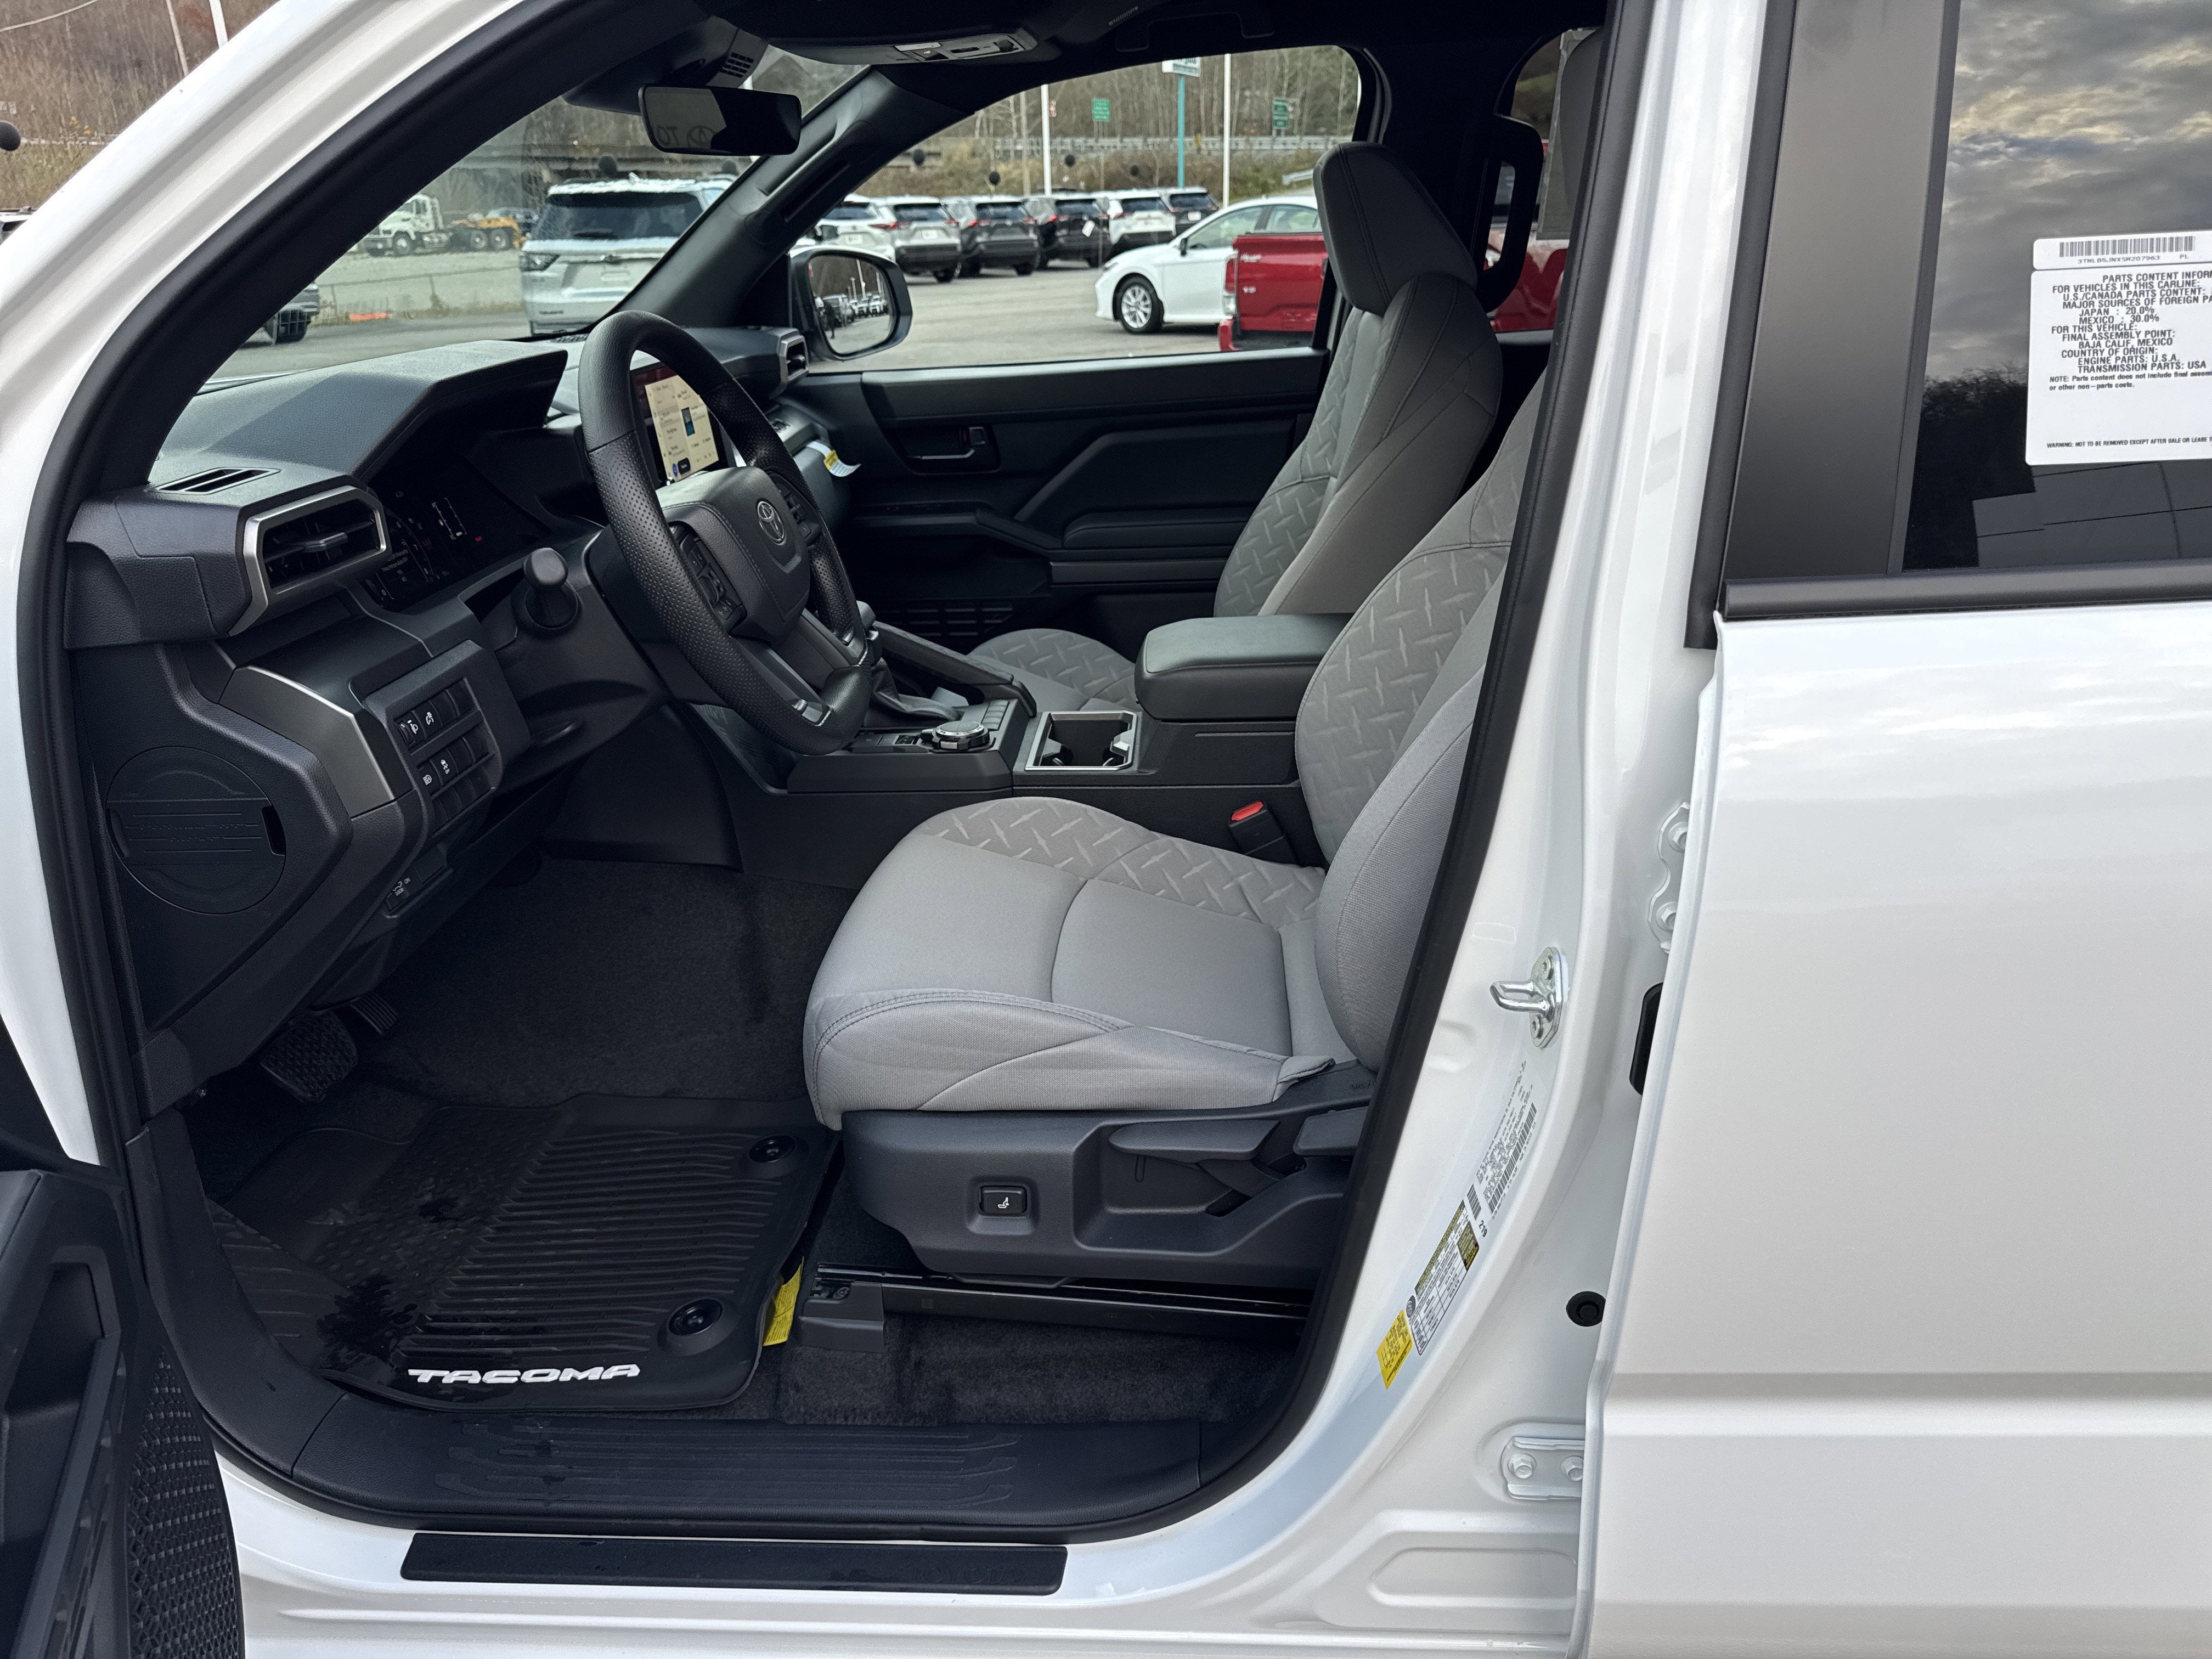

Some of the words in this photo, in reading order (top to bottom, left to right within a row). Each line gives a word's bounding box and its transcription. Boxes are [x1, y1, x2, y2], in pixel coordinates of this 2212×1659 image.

[2078, 255, 2160, 264] 3TMLB5JNXSM207963
[2102, 274, 2132, 283] PARTS
[2136, 272, 2179, 281] CONTENT
[2052, 285, 2070, 294] FOR
[2073, 283, 2117, 292] VEHICLES
[2120, 282, 2129, 290] IN
[2134, 281, 2154, 290] THIS
[2158, 279, 2200, 289] CARLINE:
[2063, 291, 2123, 301] U.S./CANADA
[2126, 290, 2156, 298] PARTS
[2160, 287, 2206, 297] CONTENT:
[2063, 300, 2095, 309] MAJOR
[2098, 298, 2140, 308] SOURCES
[2144, 297, 2156, 306] OF
[2159, 295, 2199, 305] FOREIGN
[2079, 308, 2109, 317] JAPAN
[2125, 306, 2154, 314] 20.0%
[2079, 315, 2114, 325] MEXICO
[2130, 313, 2159, 323] 30.0%
[2051, 325, 2069, 334] FOR
[2072, 324, 2093, 333] THIS
[2096, 323, 2137, 332] VEHICLE:
[2062, 333, 2088, 341] FINAL
[2091, 330, 2141, 340] ASSEMBLY
[2145, 329, 2175, 338] POINT:
[2079, 340, 2101, 349] BAJA
[2137, 337, 2172, 346] MEXICO
[2062, 348, 2105, 358] COUNTRY
[2108, 348, 2119, 357] OF
[2123, 346, 2158, 356] ORIGIN:
[2078, 356, 2112, 365] ENGINE
[2115, 354, 2148, 364] PARTS:
[2152, 353, 2180, 362] U.S.A.
[2078, 363, 2147, 373] TRANSMISSION
[2151, 362, 2184, 370] PARTS:
[2187, 360, 2207, 369] USA
[1479, 1220, 1487, 1237] 219
[408, 1364, 641, 1384] TACOMA
